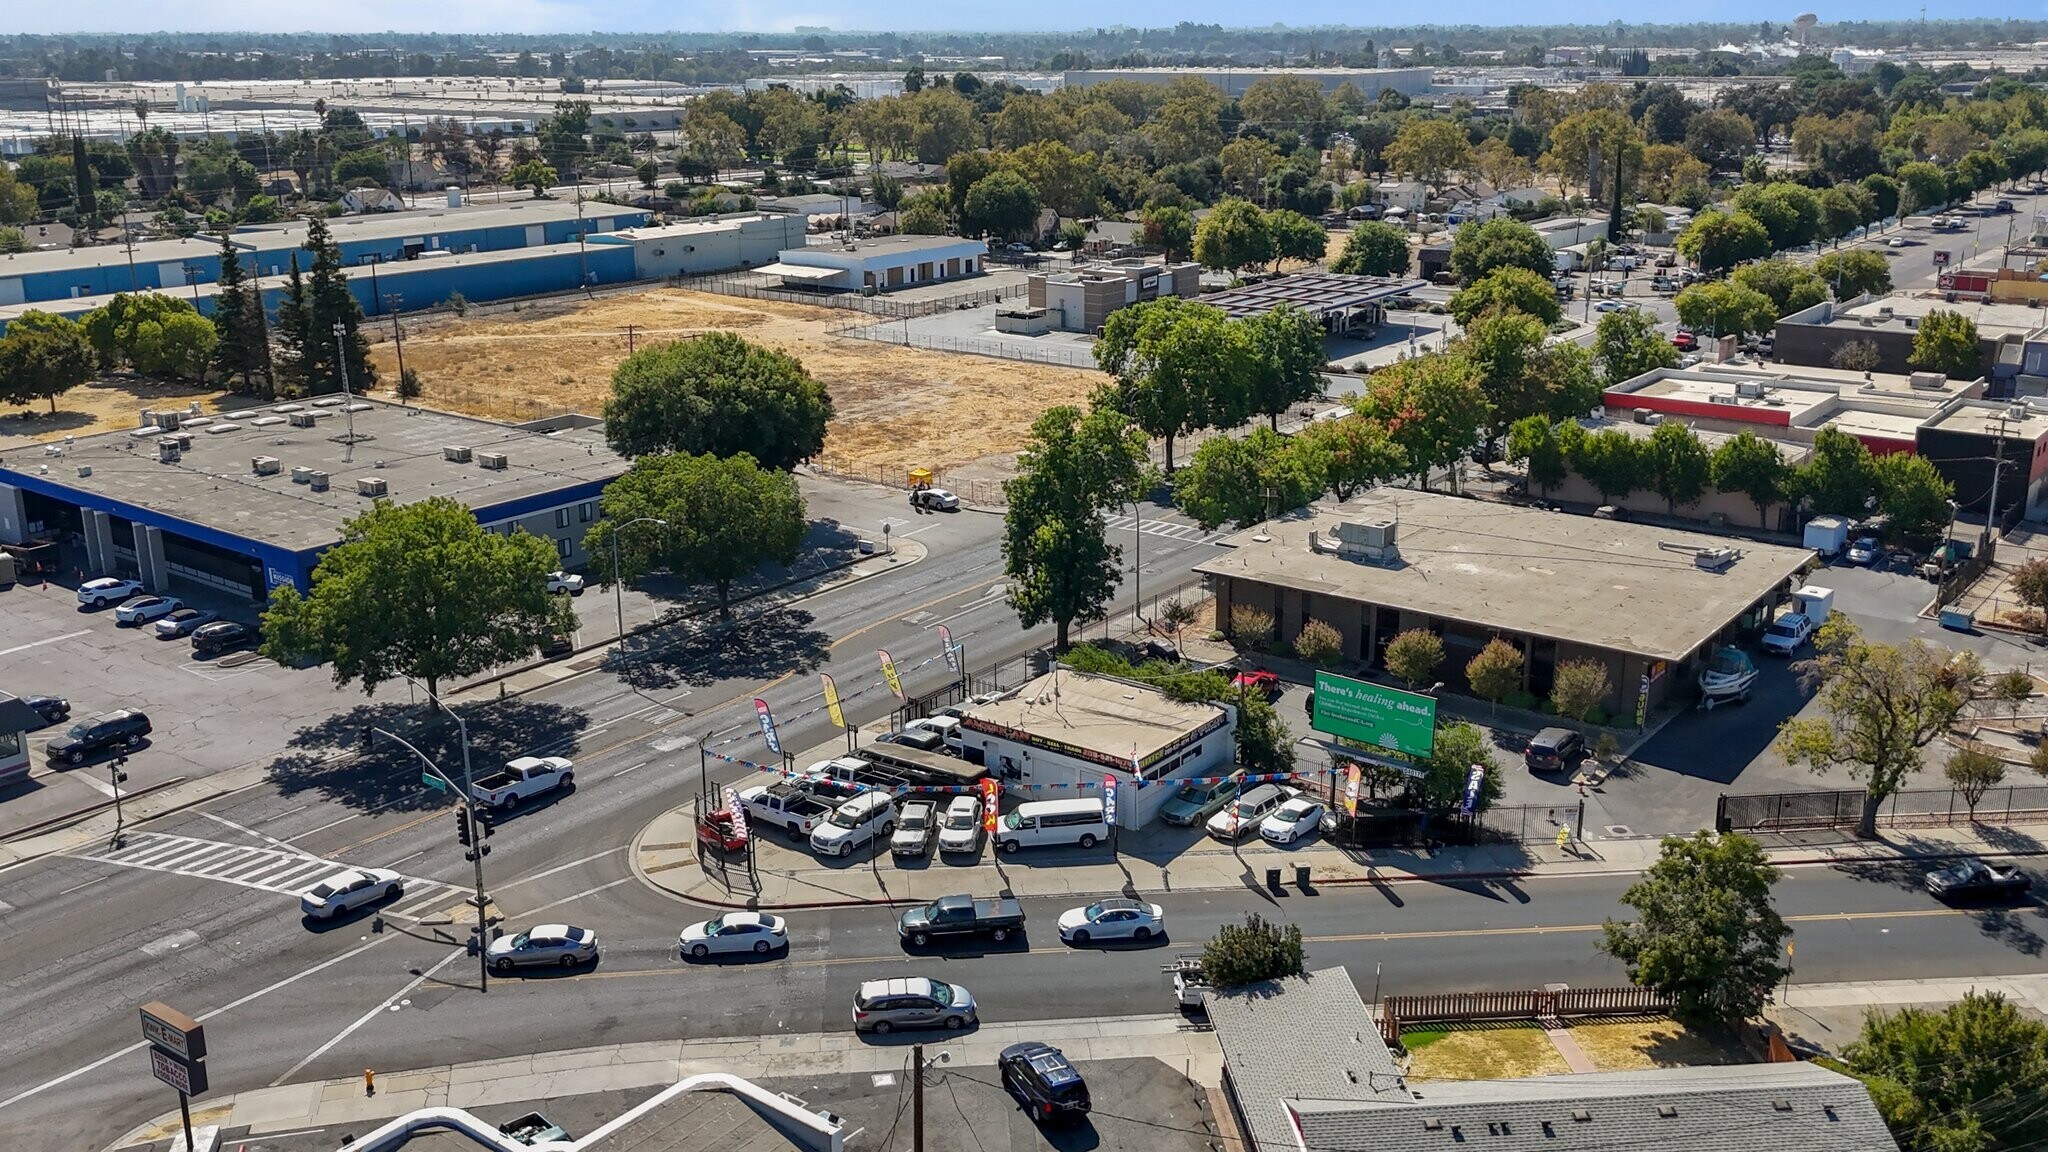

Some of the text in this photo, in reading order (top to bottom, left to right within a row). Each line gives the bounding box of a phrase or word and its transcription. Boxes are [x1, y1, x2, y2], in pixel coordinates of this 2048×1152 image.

[1318, 680, 1431, 717] There's healing ahead.
[156, 1060, 188, 1084] TOBACCO
